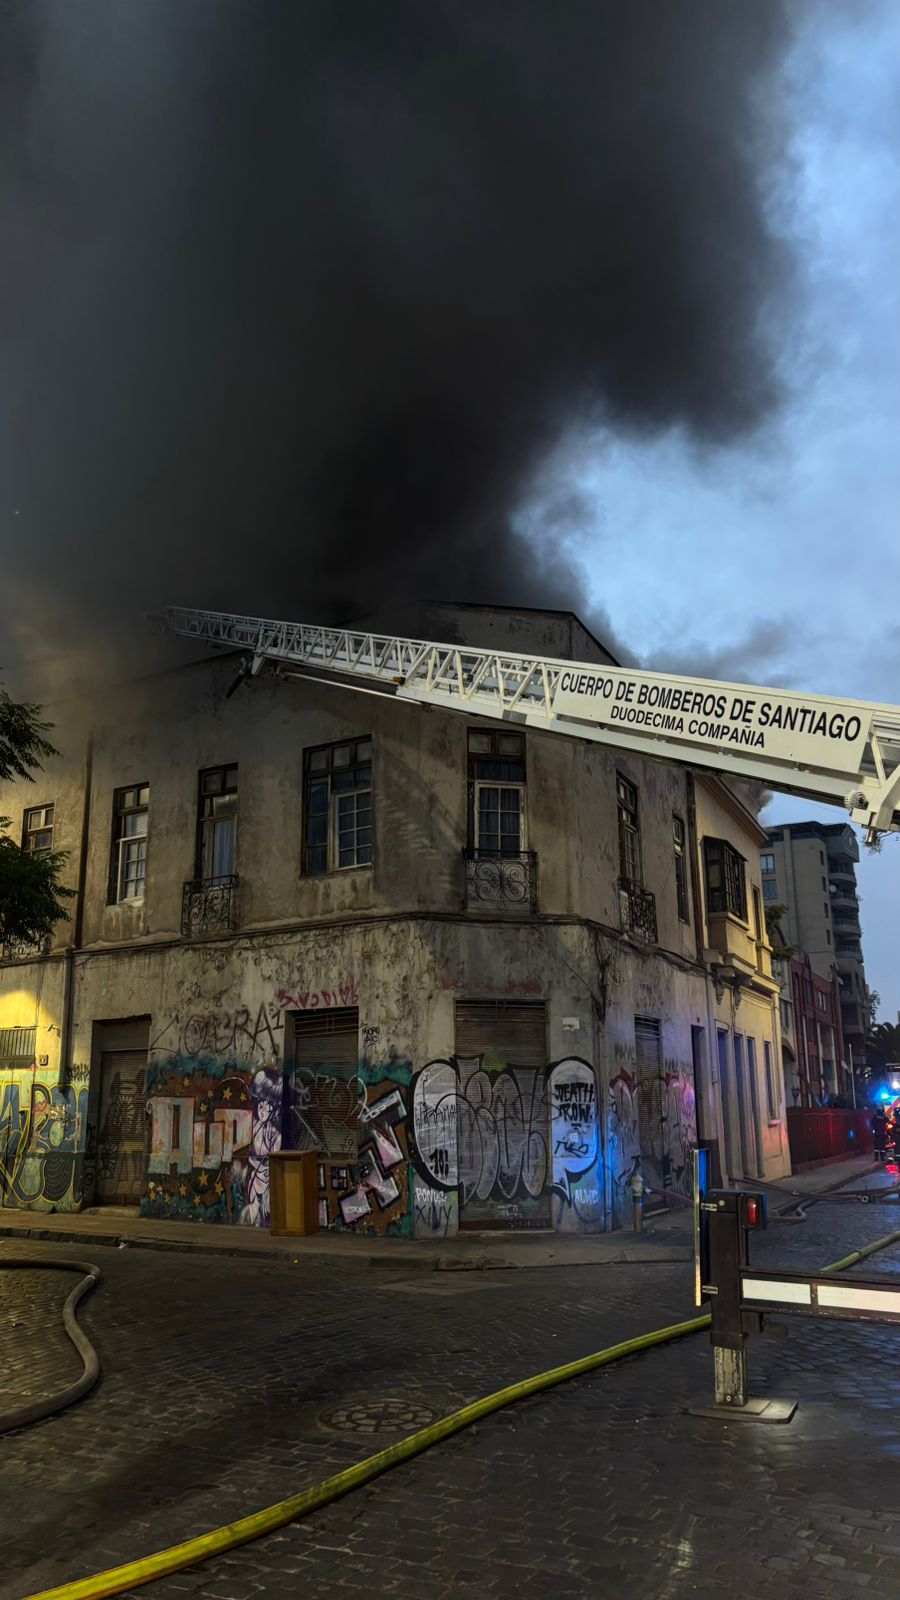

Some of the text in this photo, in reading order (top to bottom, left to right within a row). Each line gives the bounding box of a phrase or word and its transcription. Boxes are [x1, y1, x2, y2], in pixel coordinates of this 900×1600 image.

[561, 671, 862, 743] CUERPO DE BOMBEROS DE SANTIAGO
[610, 705, 765, 749] DUODECIMA COMPAÑIA
